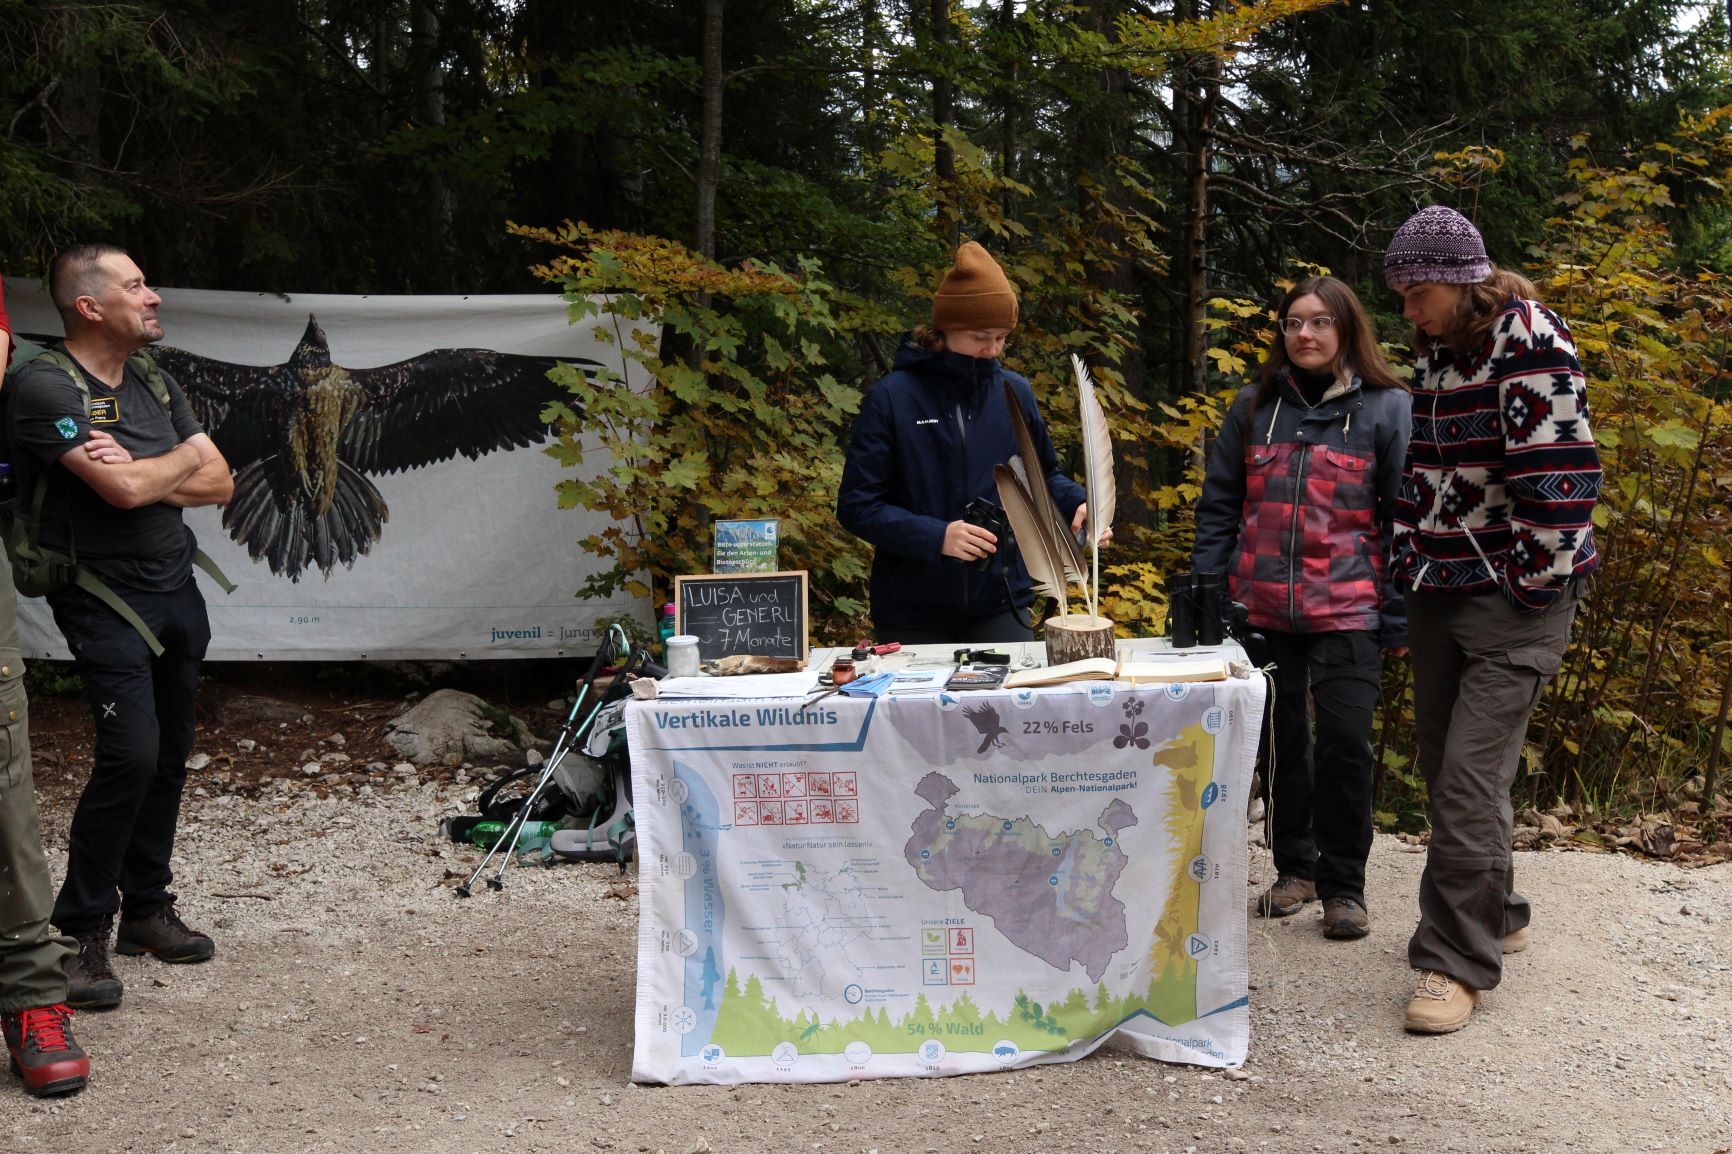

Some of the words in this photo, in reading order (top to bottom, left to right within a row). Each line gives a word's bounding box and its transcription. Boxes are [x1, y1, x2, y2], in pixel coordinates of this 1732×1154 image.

[688, 586, 745, 607] LUISA
[749, 589, 779, 604] und
[491, 626, 541, 643] juvenil
[559, 627, 599, 642] Jungv
[718, 628, 731, 651] 7
[733, 627, 792, 653] Monate
[655, 710, 751, 729] Vertikale
[756, 707, 838, 726] Wildnis
[1023, 720, 1041, 735] 22
[1043, 720, 1058, 734] %
[1062, 720, 1094, 734] Fels
[974, 772, 1048, 785] Nationalpark
[1050, 770, 1137, 783] Berchtesgaden
[1050, 782, 1138, 794] Alpen-Nationalpark!
[806, 841, 826, 849] Natur
[844, 840, 872, 848] lassen!»
[699, 849, 710, 859] 3
[702, 860, 712, 876] %
[703, 878, 714, 936] Wasser
[907, 1023, 926, 1036] 54
[928, 1023, 943, 1035] %
[946, 1022, 984, 1036] Wald
